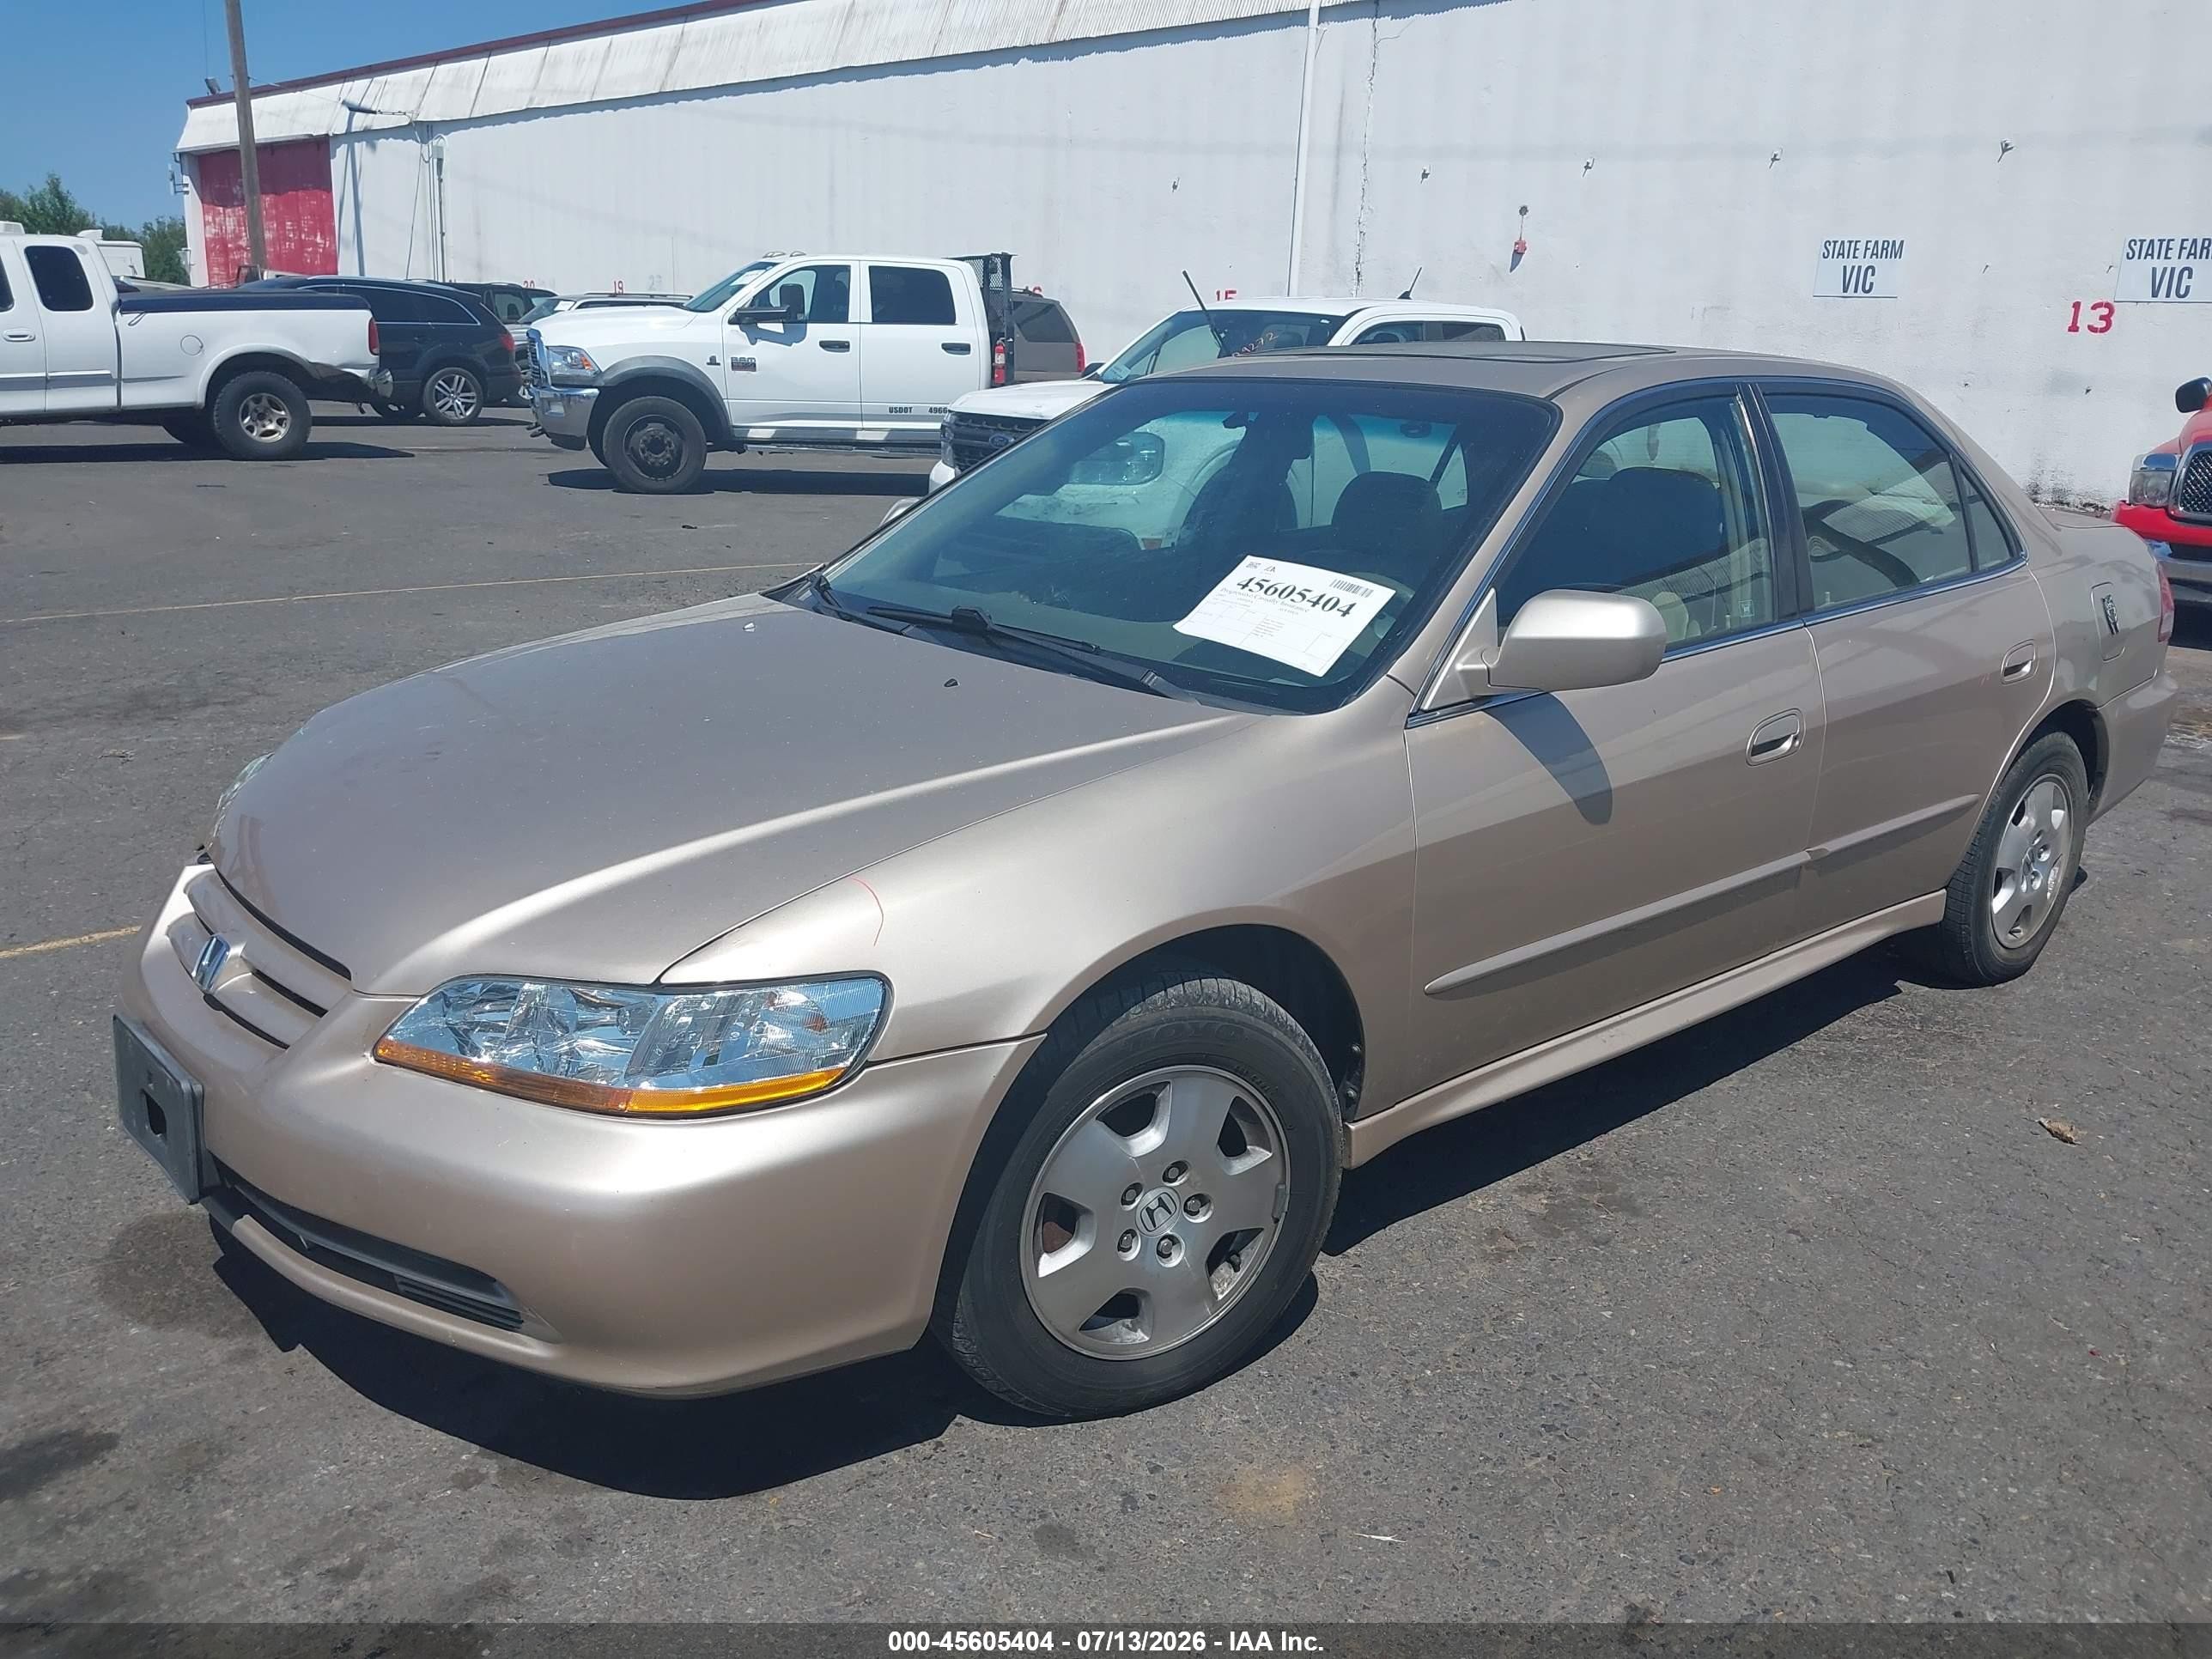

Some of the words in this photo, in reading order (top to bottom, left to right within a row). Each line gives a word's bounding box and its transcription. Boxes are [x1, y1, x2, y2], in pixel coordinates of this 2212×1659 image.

[1822, 240, 1861, 258] STATE
[1863, 240, 1905, 259] FARM
[2125, 238, 2175, 260] STATE
[2177, 237, 2212, 260] FAR
[614, 280, 624, 295] 19
[1842, 264, 1876, 295] VIC
[2151, 266, 2194, 299] VIC
[2068, 301, 2115, 333] 13
[1237, 576, 1357, 617] 45605404
